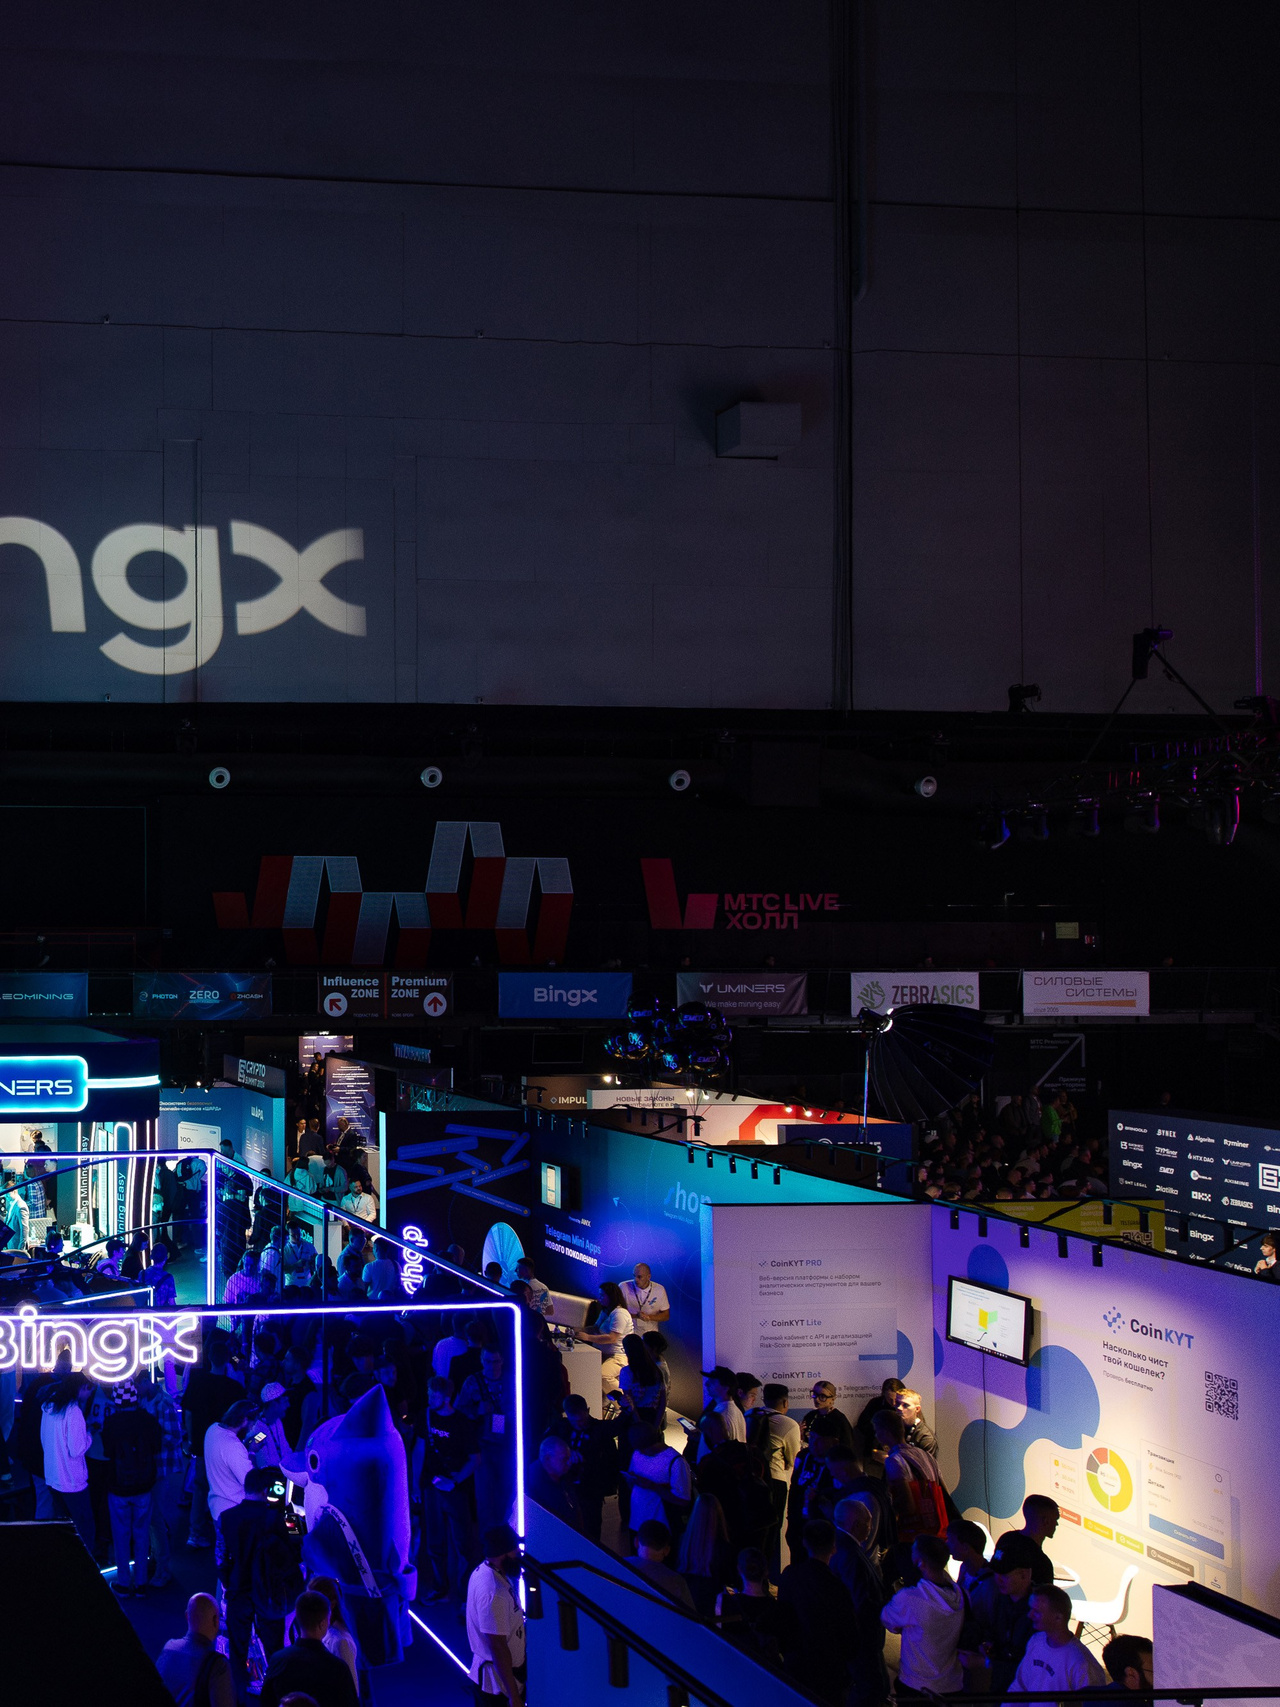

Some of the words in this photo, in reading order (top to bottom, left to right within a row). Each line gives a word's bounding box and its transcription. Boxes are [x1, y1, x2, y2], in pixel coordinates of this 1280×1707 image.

[784, 893, 840, 911] LIVE
[724, 912, 799, 930] ХОЛЛ
[323, 976, 379, 987] Influence
[391, 976, 448, 987] Premium
[1034, 977, 1103, 987] СИЛОВЫЕ
[189, 990, 220, 1000] ZERO
[351, 988, 379, 998] ZONE
[391, 988, 420, 998] ZONE
[717, 984, 786, 994] UMINERS
[891, 984, 974, 1005] ZEBRASICS
[1065, 988, 1137, 998] СИСТЕМЫ
[533, 985, 598, 1007] Bingx
[704, 1000, 718, 1008] We
[739, 1000, 761, 1011] mining
[762, 1001, 782, 1011] easy
[245, 1061, 266, 1078] CRYPTO
[1122, 1160, 1143, 1169] Bingx
[118, 1172, 126, 1200] Easy
[545, 1224, 571, 1243] Telegram
[572, 1234, 585, 1247] Mini
[585, 1240, 601, 1255] Apps
[1190, 1230, 1214, 1242] Bingx
[545, 1239, 565, 1254] нового
[565, 1248, 598, 1268] поколения
[771, 1260, 804, 1268] CoinKYT
[806, 1259, 822, 1267] PRO
[771, 1319, 805, 1327] CoinKYT
[806, 1318, 822, 1327] Lite
[1130, 1318, 1194, 1349] CoinKYT
[1103, 1340, 1146, 1362] Насколько
[1148, 1351, 1169, 1368] чист
[1103, 1353, 1122, 1370] твой
[1123, 1359, 1166, 1381] кошелек?
[772, 1371, 805, 1379] CoinKYT
[807, 1371, 822, 1379] Bot
[1103, 1369, 1124, 1384] Проверь
[1124, 1376, 1154, 1392] бесплатно
[1147, 1449, 1175, 1465] Транзакция
